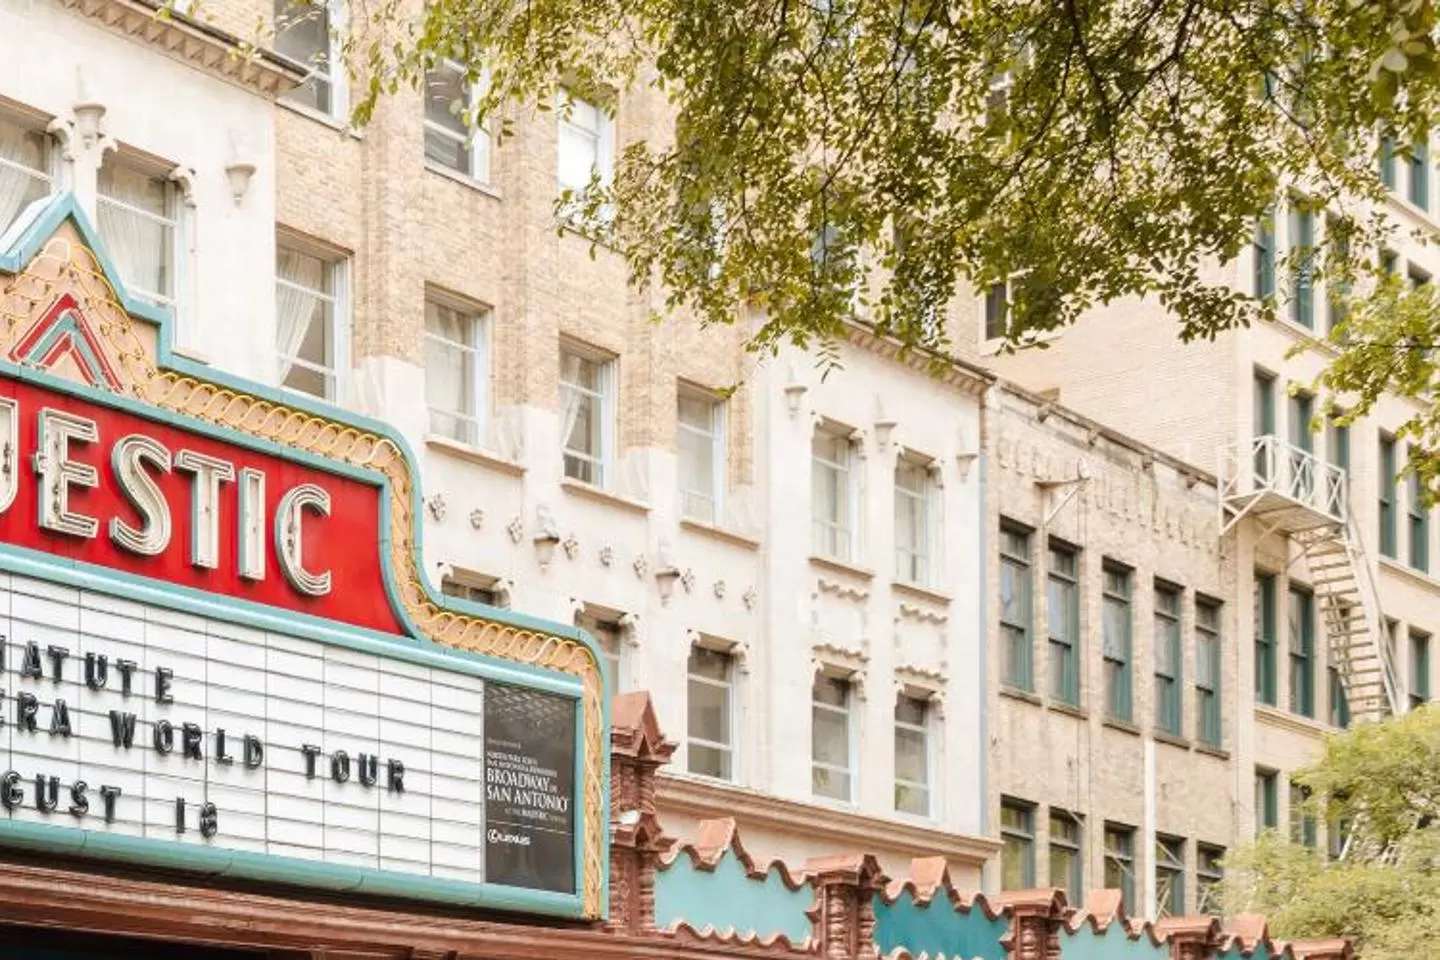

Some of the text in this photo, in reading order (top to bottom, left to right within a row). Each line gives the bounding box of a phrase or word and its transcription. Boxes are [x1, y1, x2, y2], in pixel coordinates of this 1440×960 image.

[110, 708, 264, 771] WORLD
[301, 743, 406, 794] TOUR
[487, 767, 550, 792] BROADWAY
[487, 784, 568, 813] SAN ANTONIO
